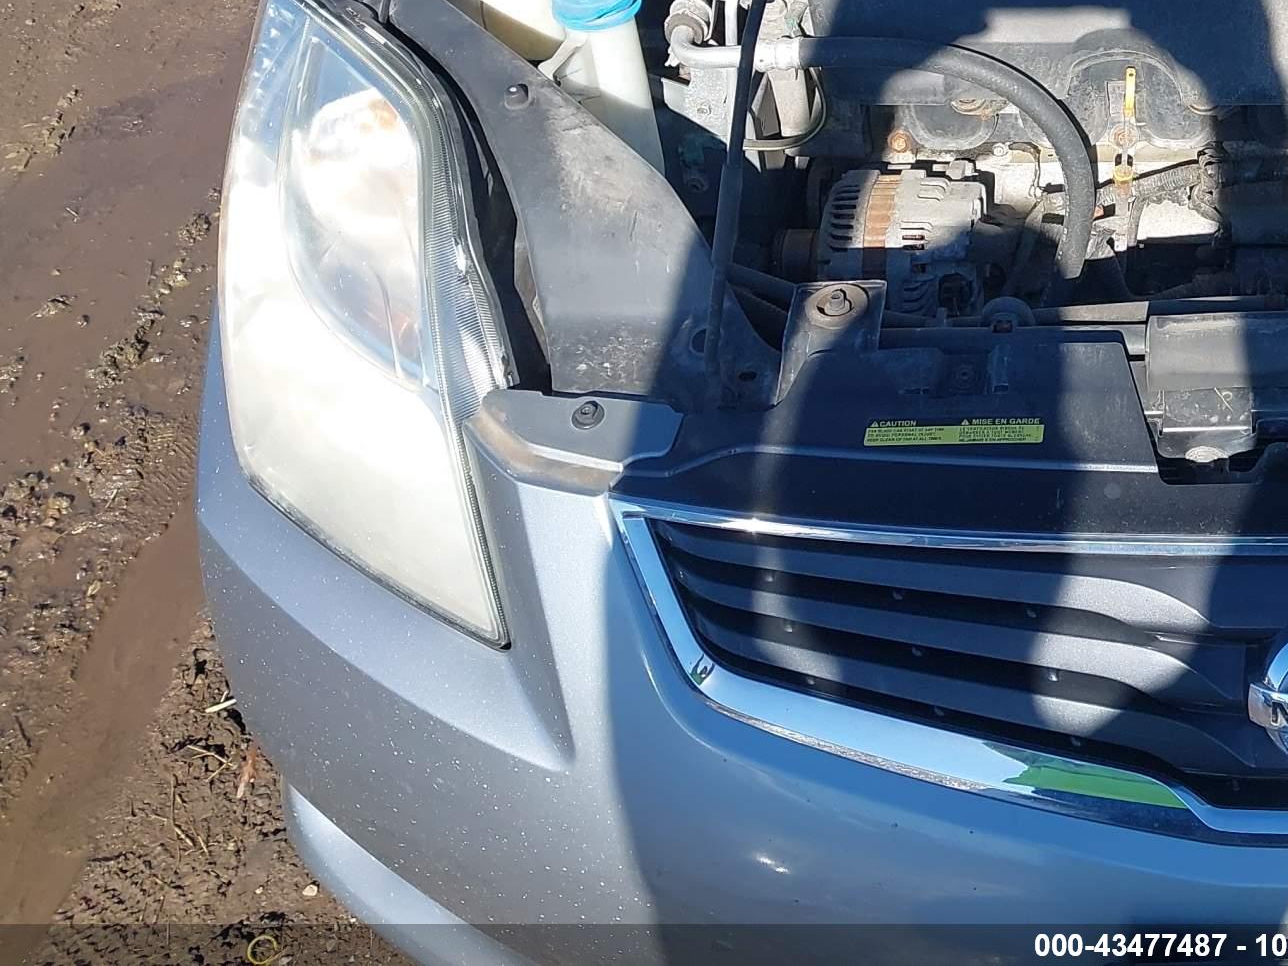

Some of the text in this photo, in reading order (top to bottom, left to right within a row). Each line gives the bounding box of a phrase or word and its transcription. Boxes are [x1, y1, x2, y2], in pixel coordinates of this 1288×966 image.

[879, 420, 917, 428] CAUTION
[971, 418, 993, 426] MISE
[1009, 417, 1041, 425] GARDE
